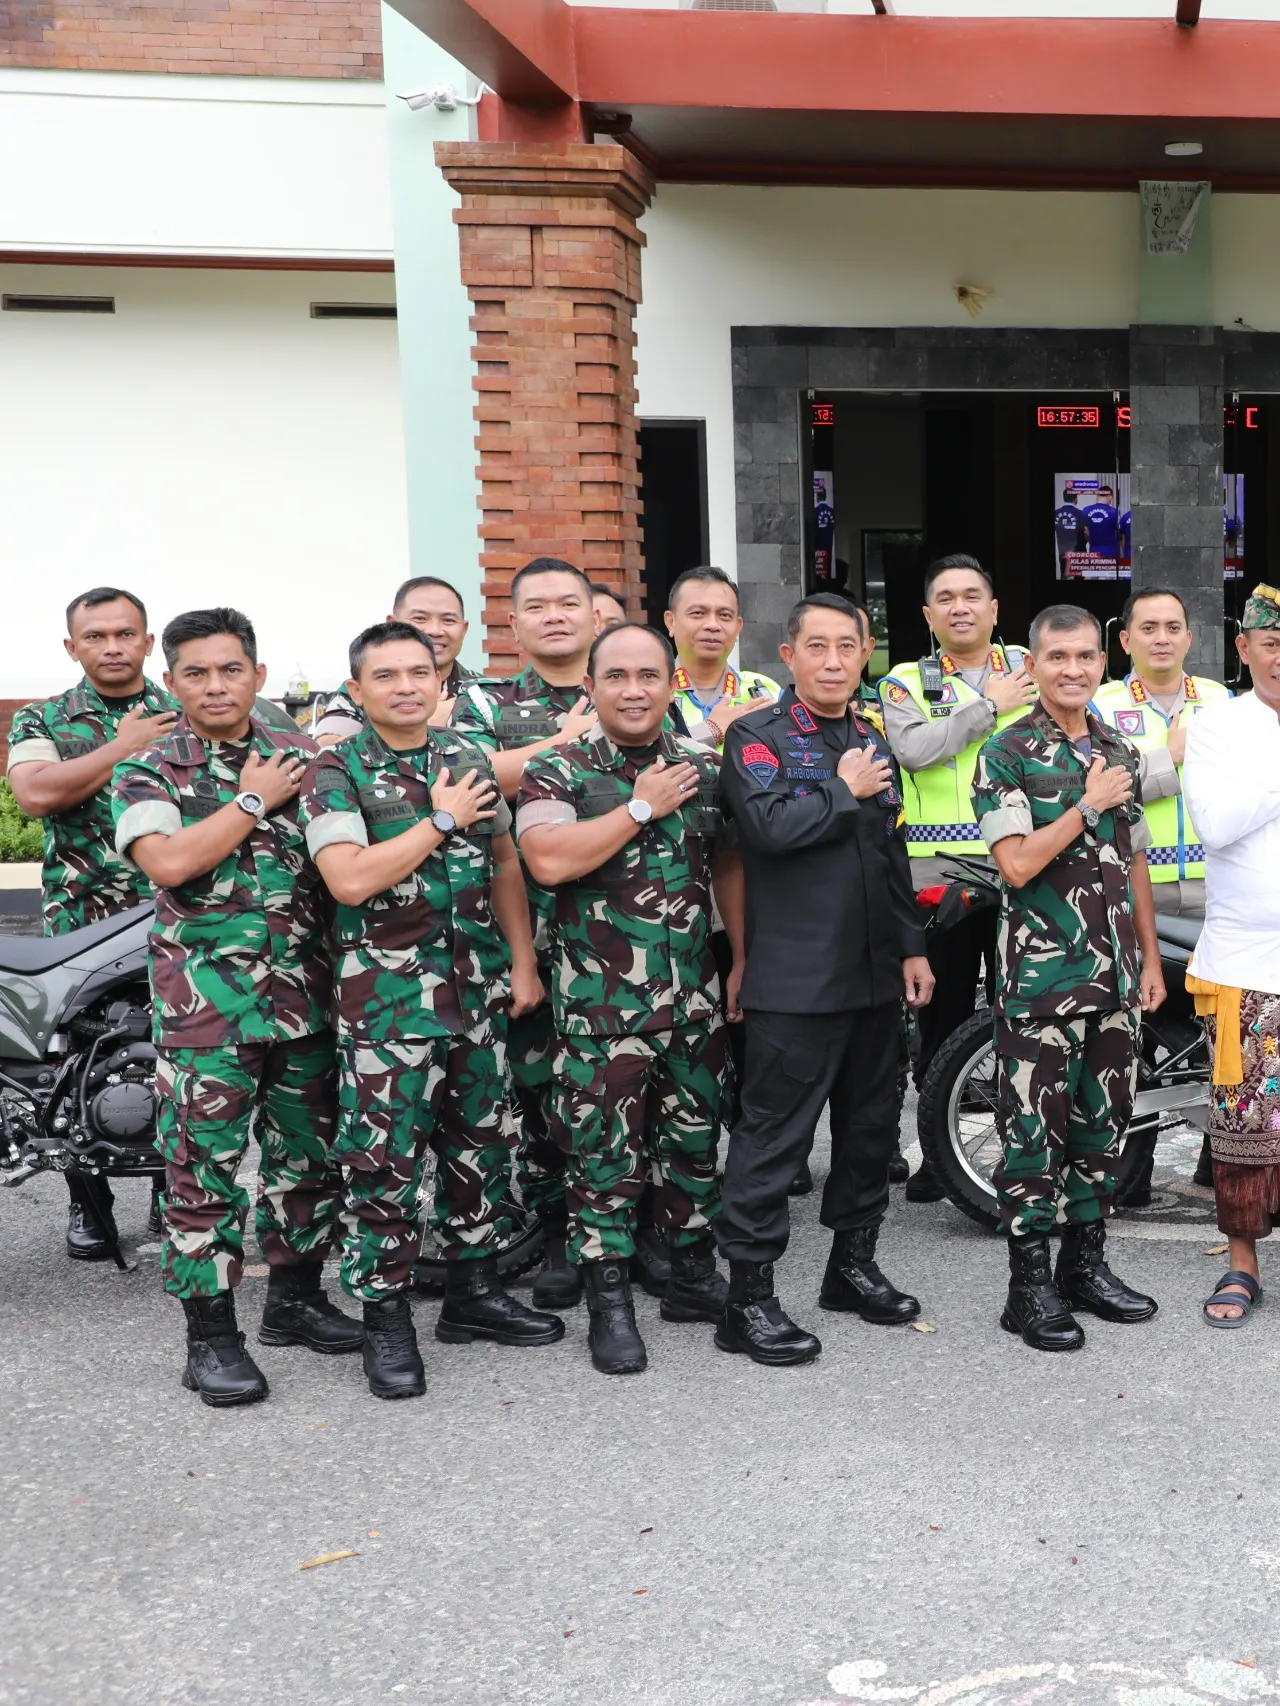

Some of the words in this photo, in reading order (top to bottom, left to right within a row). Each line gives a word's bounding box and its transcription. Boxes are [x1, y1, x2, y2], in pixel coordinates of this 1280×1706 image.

[1041, 411, 1096, 422] 16:57:35
[503, 723, 550, 735] INDRA
[104, 1106, 149, 1115] HONDA
